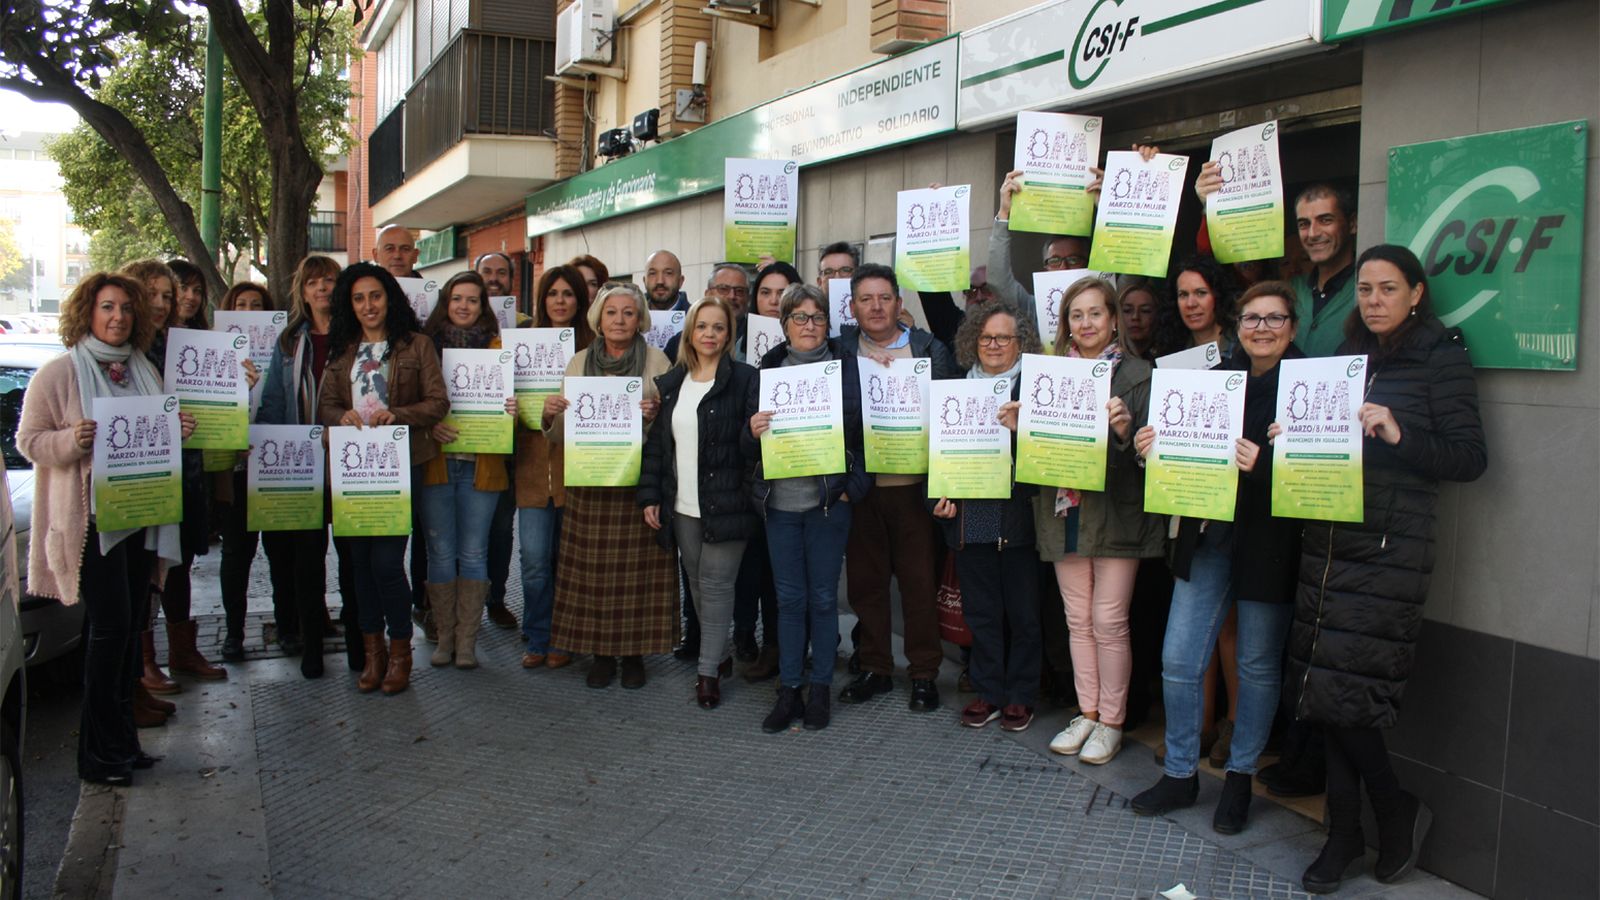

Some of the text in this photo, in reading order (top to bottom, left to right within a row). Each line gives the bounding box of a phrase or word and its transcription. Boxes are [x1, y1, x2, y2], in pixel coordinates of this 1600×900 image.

[760, 60, 941, 134] PROFESIONAL INDEPENDIENTE
[792, 126, 862, 157] REIVINDICATIVO
[878, 105, 940, 134] SOLIDARIO
[1031, 410, 1096, 420] MARZO/8/MUJER
[1159, 430, 1228, 440] MARZO/8/MUJER
